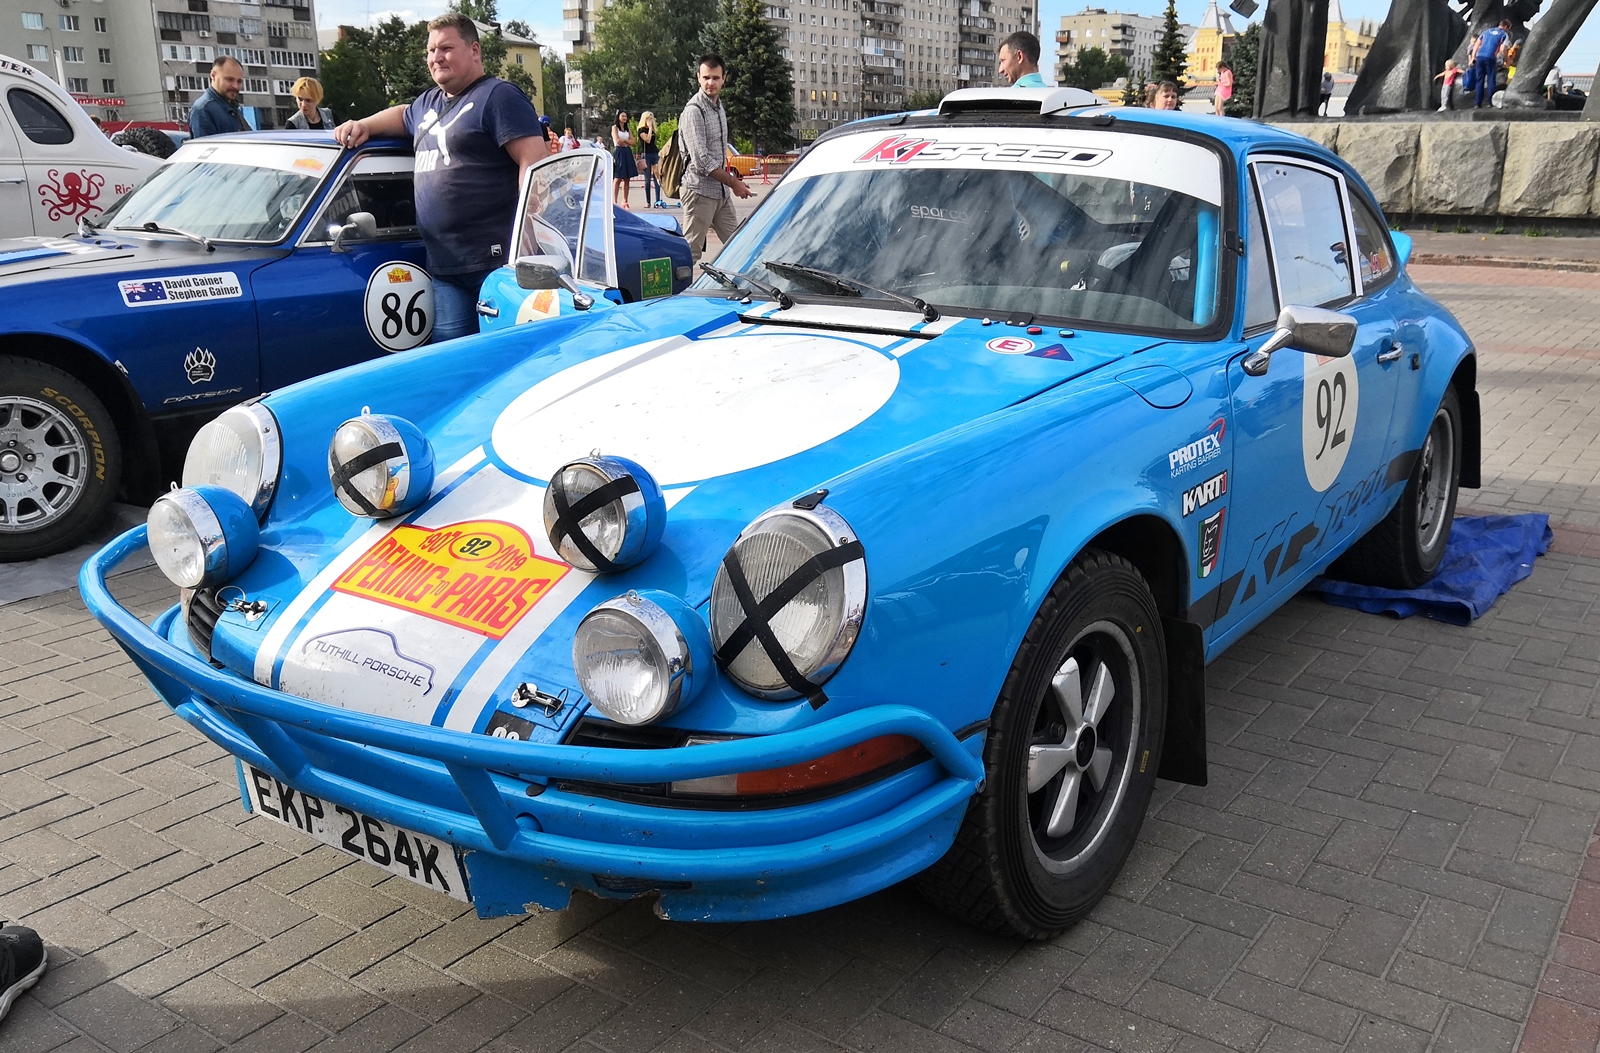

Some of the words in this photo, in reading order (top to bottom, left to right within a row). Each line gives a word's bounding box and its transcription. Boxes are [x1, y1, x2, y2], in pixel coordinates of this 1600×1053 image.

[164, 278, 191, 289] David
[192, 276, 223, 287] Gainer
[168, 288, 208, 301] Stephen
[209, 286, 239, 297] Gainer
[381, 289, 426, 339] 86
[996, 339, 1023, 351] E
[163, 387, 243, 404] DATSUN
[1316, 372, 1346, 460] 92
[40, 387, 105, 480] SCORPION
[1168, 431, 1220, 470] PROTEX
[1170, 458, 1197, 479] KARTING
[1198, 447, 1222, 466] BARRIER
[342, 536, 450, 603] PEKING
[418, 530, 463, 554] 1907
[459, 538, 492, 556] 92
[485, 544, 528, 572] 2019
[430, 579, 450, 596] TO
[431, 572, 551, 630] PARIS
[315, 640, 360, 665] TUTHILL
[361, 657, 426, 687] PORSCHE
[250, 766, 325, 834] EKP
[335, 804, 451, 892] 264K
